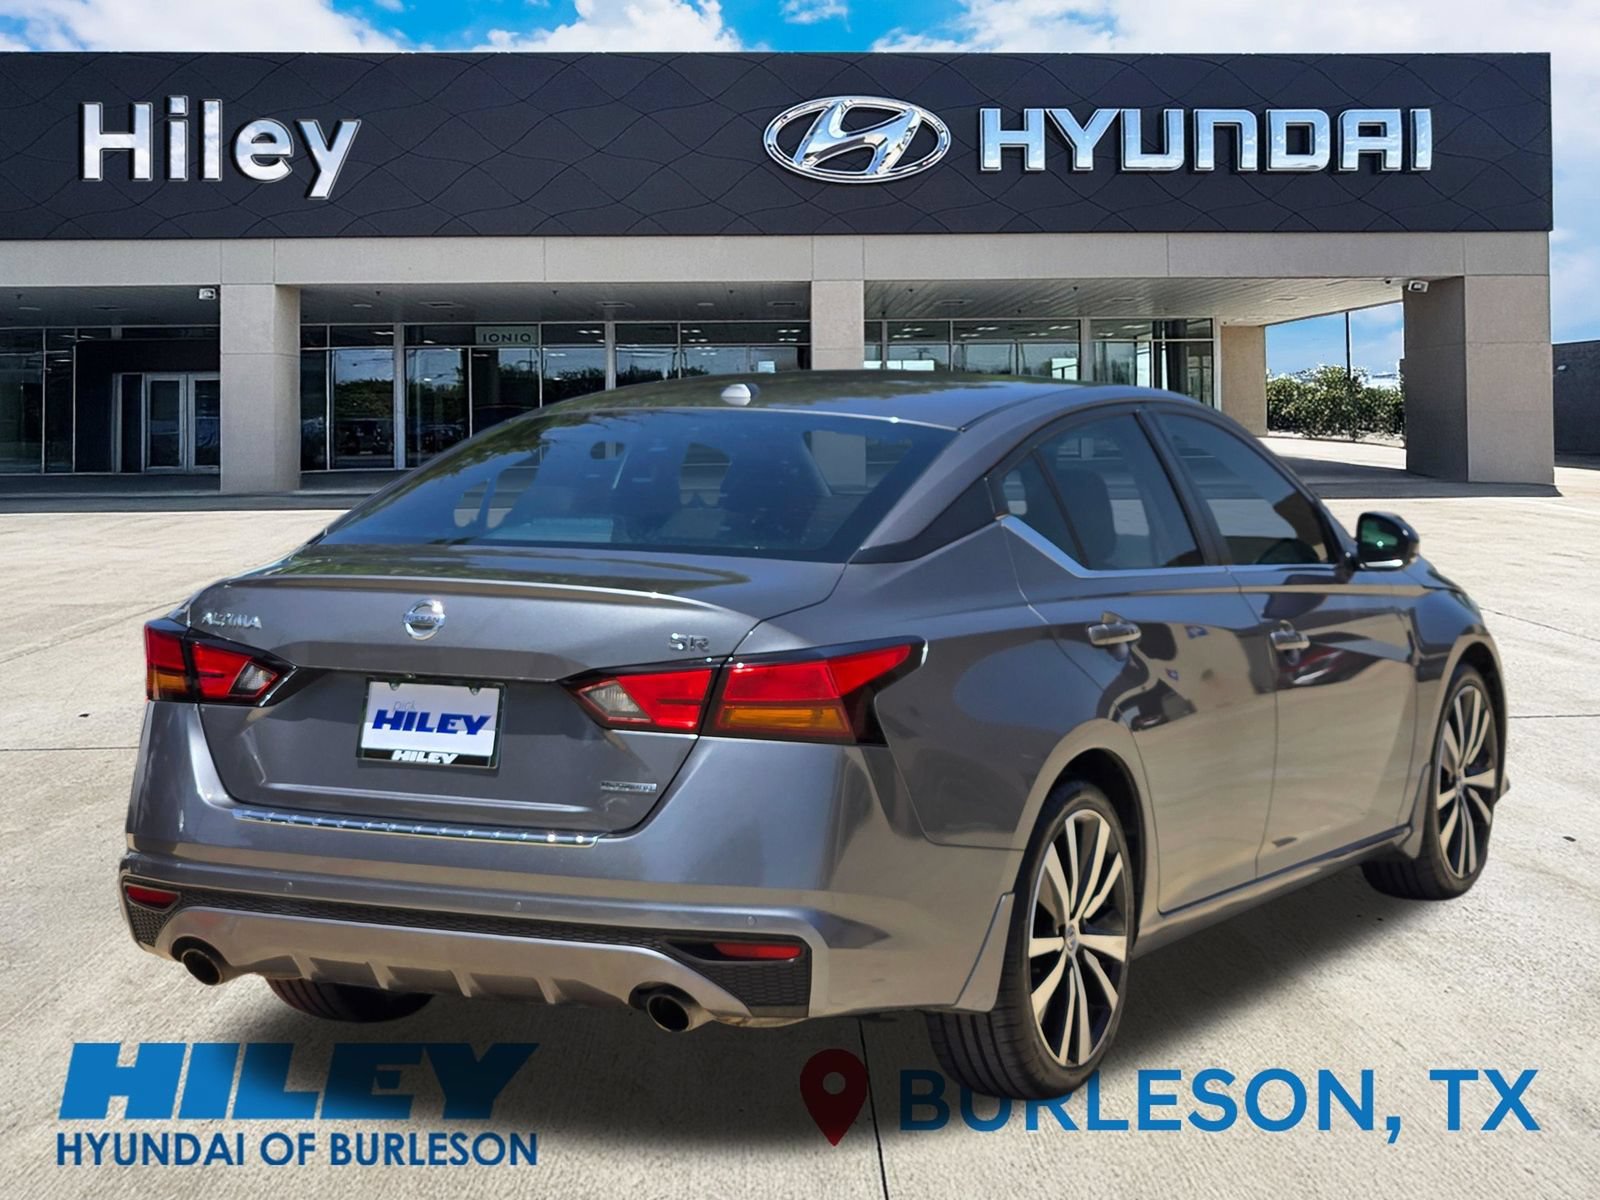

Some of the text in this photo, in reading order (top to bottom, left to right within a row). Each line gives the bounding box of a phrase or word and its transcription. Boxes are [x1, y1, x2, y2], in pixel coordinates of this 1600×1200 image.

[80, 95, 362, 200] Hiley
[979, 107, 1434, 172] HYUNDAI
[669, 633, 710, 651] SR
[372, 709, 492, 736] HILEY
[391, 749, 459, 765] HILEY
